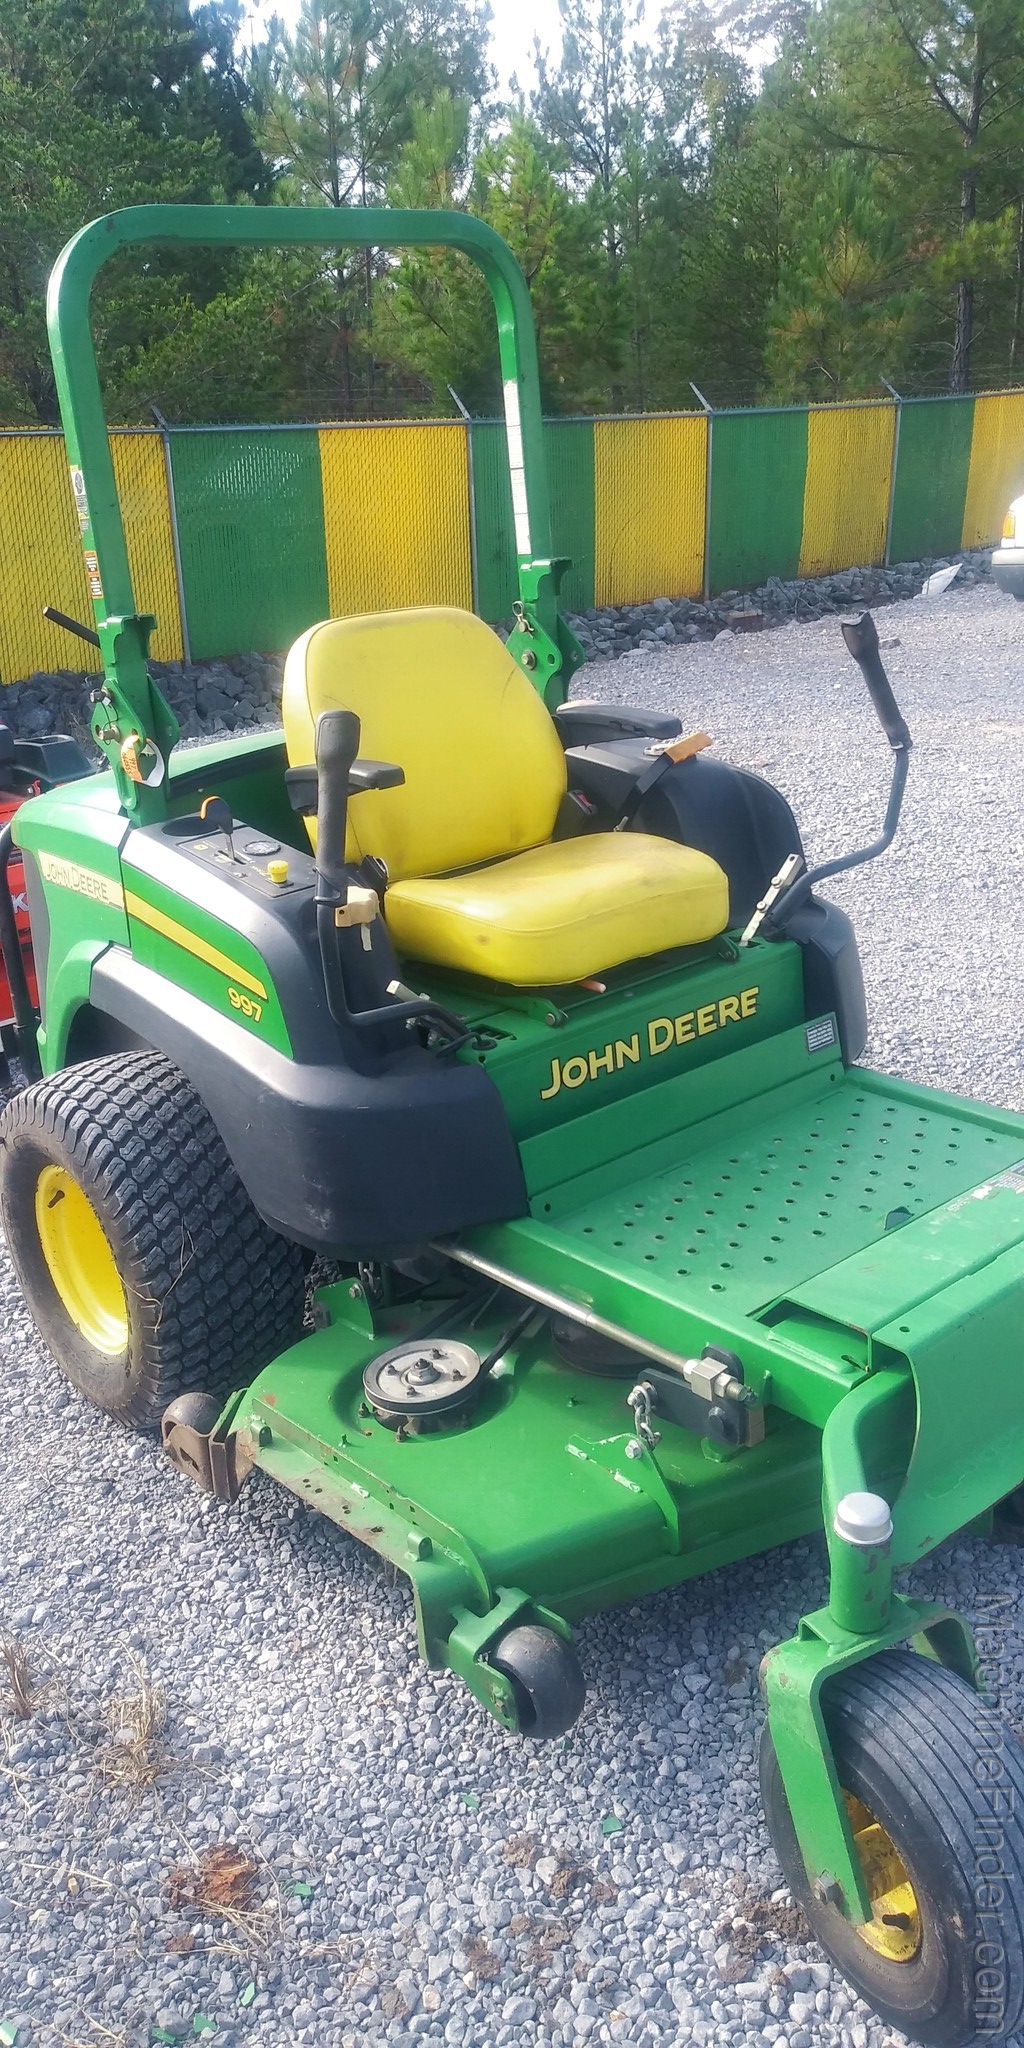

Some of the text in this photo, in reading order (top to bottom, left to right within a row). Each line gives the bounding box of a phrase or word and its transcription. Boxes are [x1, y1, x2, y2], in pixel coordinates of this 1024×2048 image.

[46, 862, 110, 901] JOHN DEERE
[226, 986, 264, 1023] 997
[540, 1033, 640, 1101] JOHN
[647, 986, 760, 1056] DEERE
